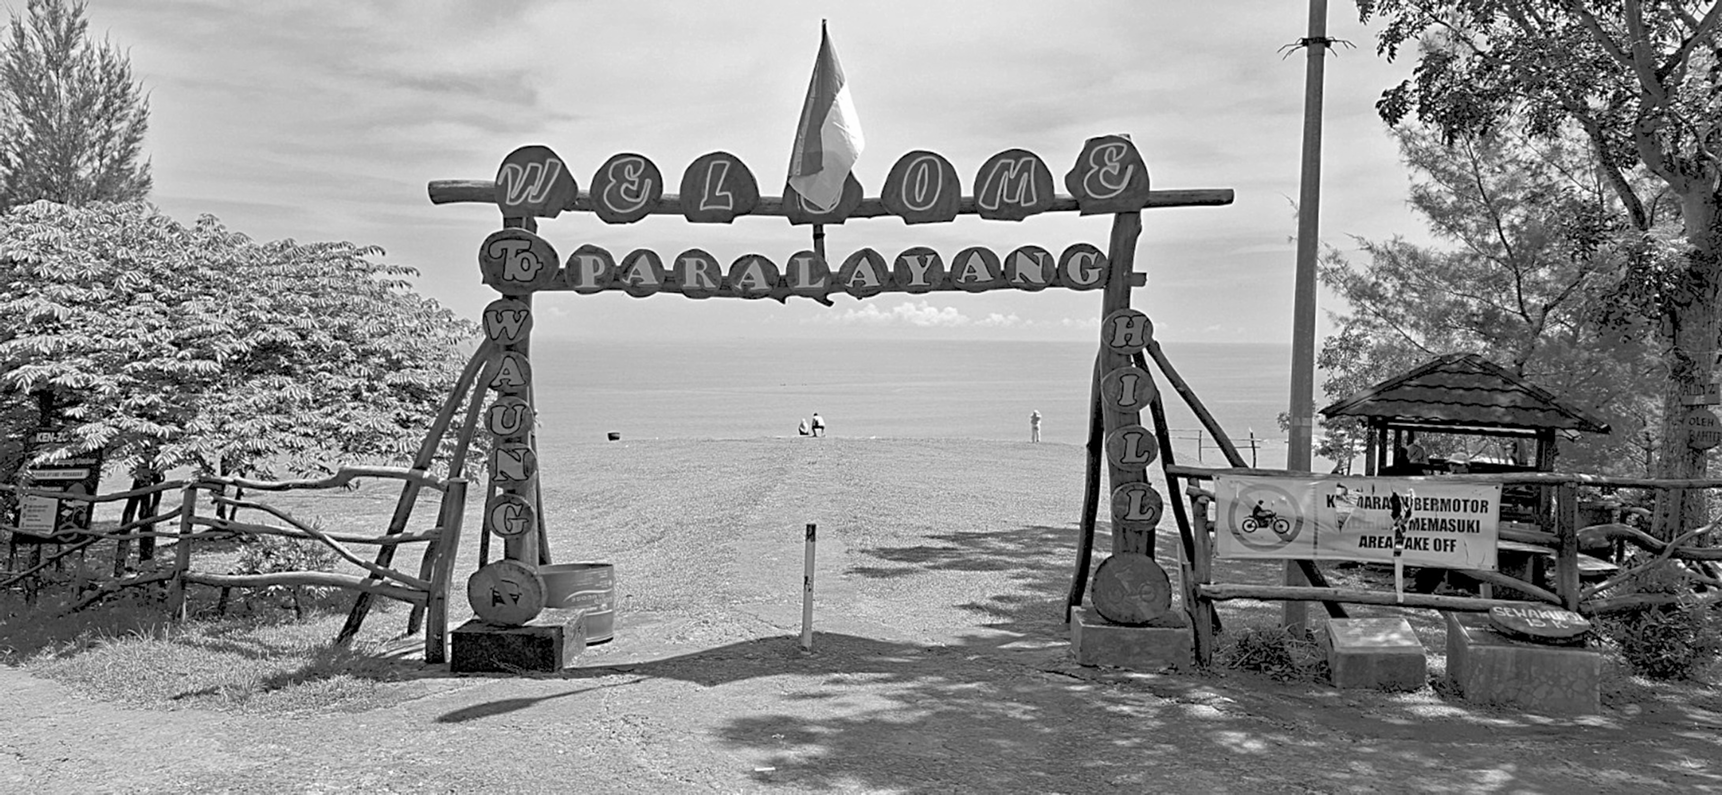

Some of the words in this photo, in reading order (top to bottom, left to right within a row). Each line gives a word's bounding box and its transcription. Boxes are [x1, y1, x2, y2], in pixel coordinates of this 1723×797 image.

[572, 249, 1102, 291] PARALAYANG
[484, 309, 529, 535] WAUNG
[1110, 315, 1155, 521] HILL
[1688, 416, 1715, 427] OLEH
[1414, 496, 1489, 514] BERMOTOR
[1409, 517, 1481, 534] MEMASUKI
[1358, 535, 1393, 549] AREA
[1433, 538, 1457, 553] OFF
